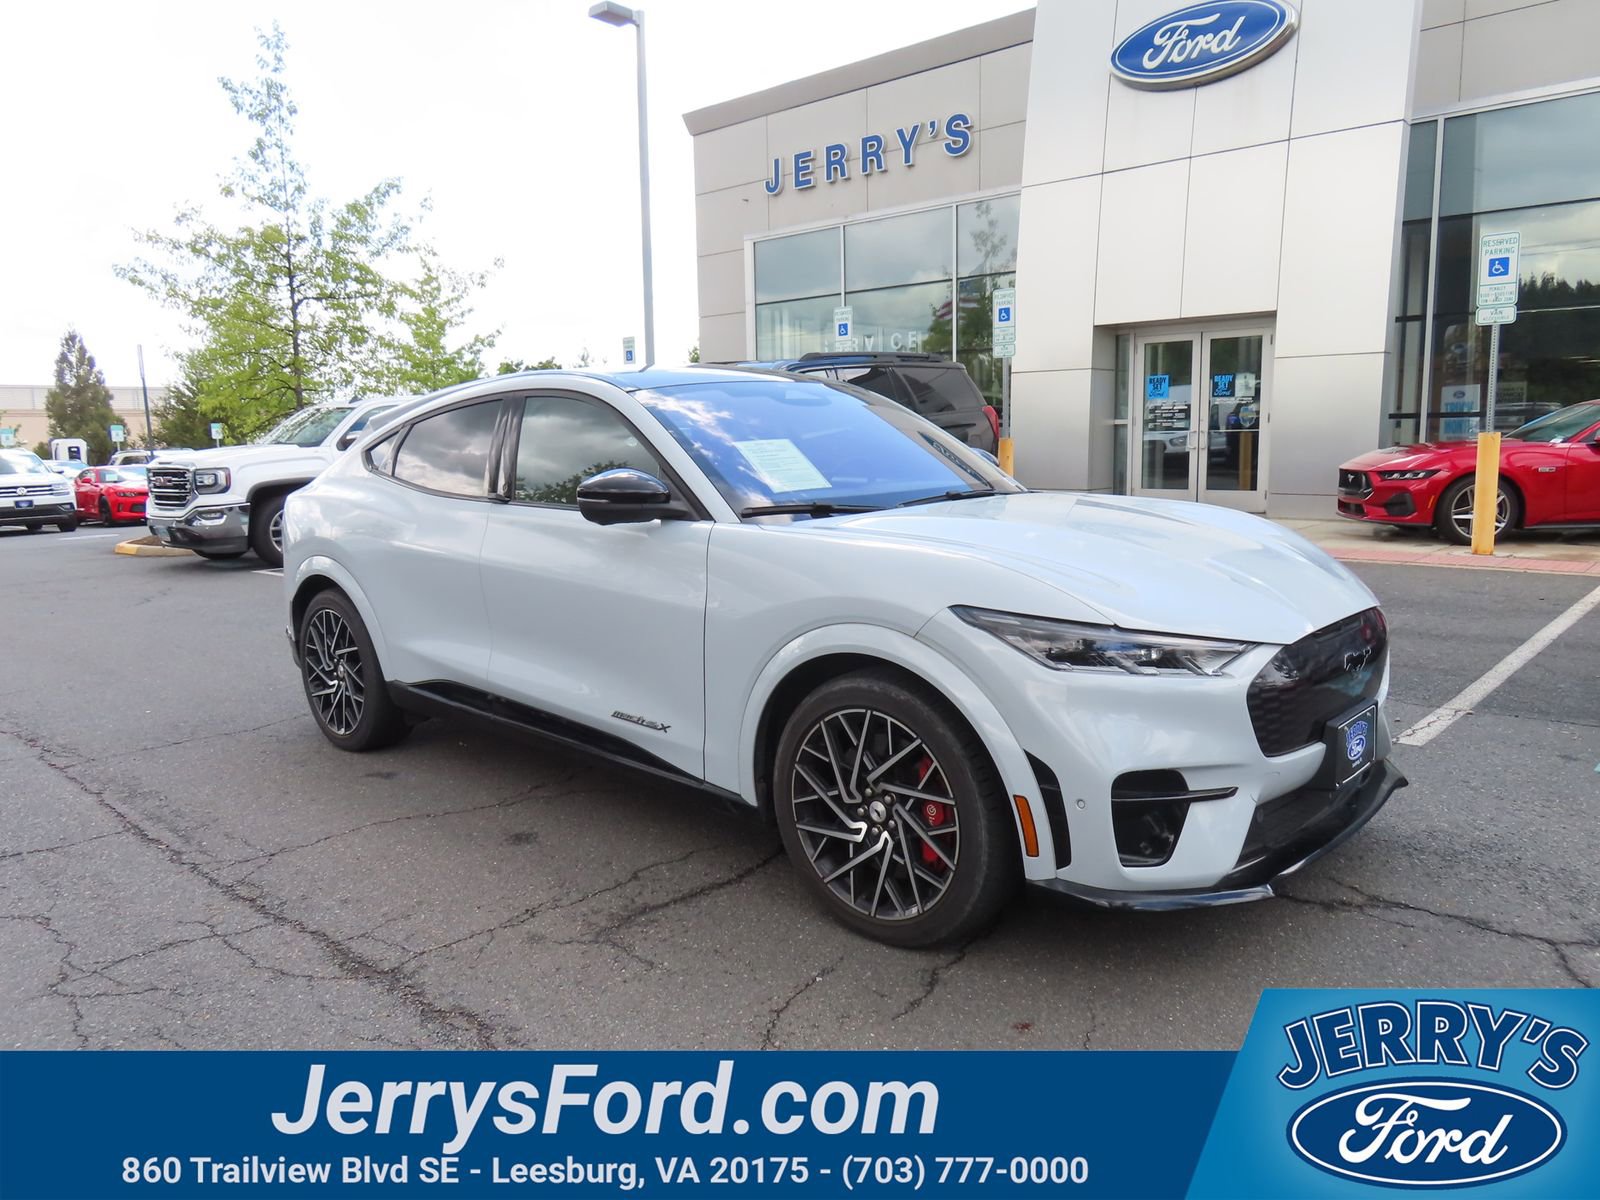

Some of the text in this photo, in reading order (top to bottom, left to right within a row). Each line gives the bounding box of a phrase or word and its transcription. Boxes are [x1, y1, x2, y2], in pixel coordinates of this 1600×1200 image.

[1142, 13, 1247, 70] Ford
[764, 113, 973, 195] JERRY'S
[1483, 237, 1518, 247] RESERVED
[1485, 247, 1515, 256] PARKING
[1148, 376, 1167, 384] READY
[1217, 381, 1229, 389] SET
